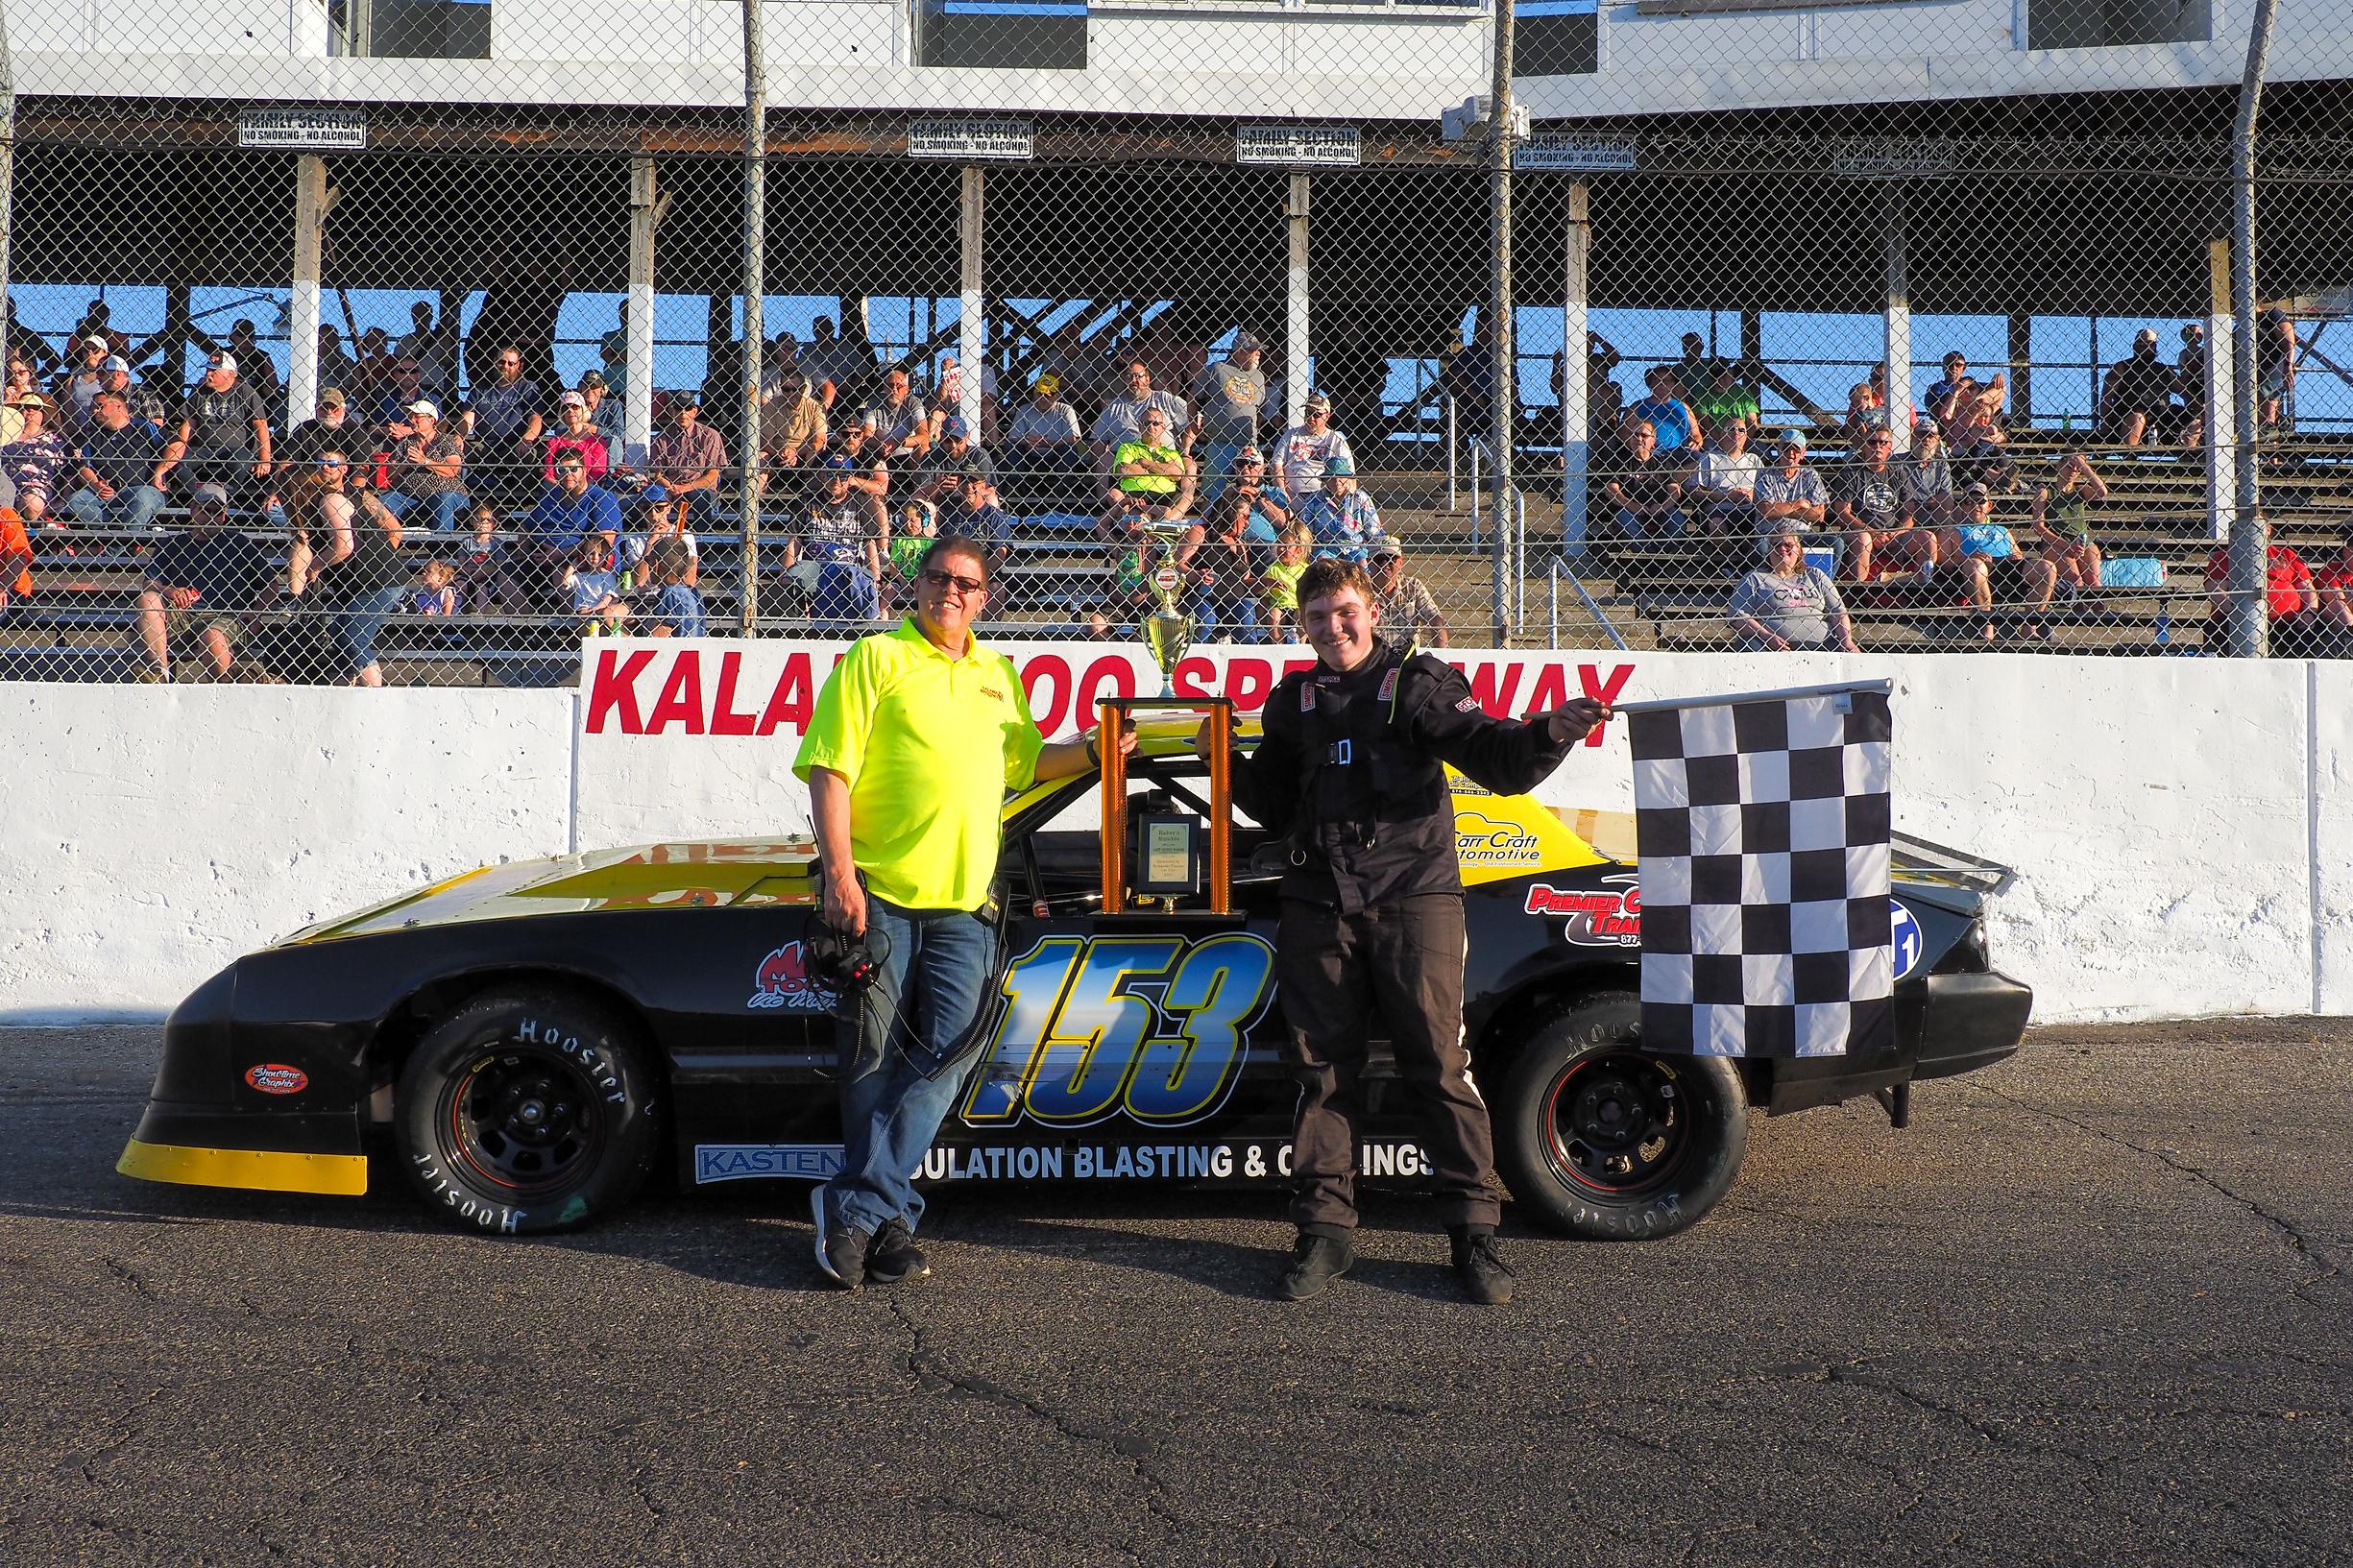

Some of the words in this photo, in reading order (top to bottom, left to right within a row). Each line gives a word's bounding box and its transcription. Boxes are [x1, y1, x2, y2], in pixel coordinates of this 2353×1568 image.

[244, 131, 256, 140] NO
[258, 131, 299, 140] SMOKING
[307, 131, 319, 140] NO
[321, 131, 361, 141] ALCOHOL
[913, 140, 925, 150] NO
[927, 140, 968, 150] SMOKING
[976, 141, 987, 150] NO
[989, 141, 1029, 151] ALCOHOL
[1242, 147, 1253, 156] NO
[1255, 147, 1296, 157] SMOKING
[1304, 147, 1316, 157] NO
[1317, 148, 1356, 157] ALCOHOL
[1519, 154, 1531, 162] NO
[1533, 154, 1574, 162] SMOKING
[1582, 154, 1593, 162] NO
[1594, 155, 1633, 163] ALCOHOL
[1382, 670, 1398, 698] SIMPSON
[1490, 832, 1539, 849] Craft
[1456, 849, 1540, 860] tomotive
[960, 933, 1278, 1127] 153
[253, 1067, 301, 1078] Showtime
[257, 1076, 295, 1088] Graphix
[1074, 1146, 1232, 1178] BLASTING
[1245, 1146, 1267, 1177] &
